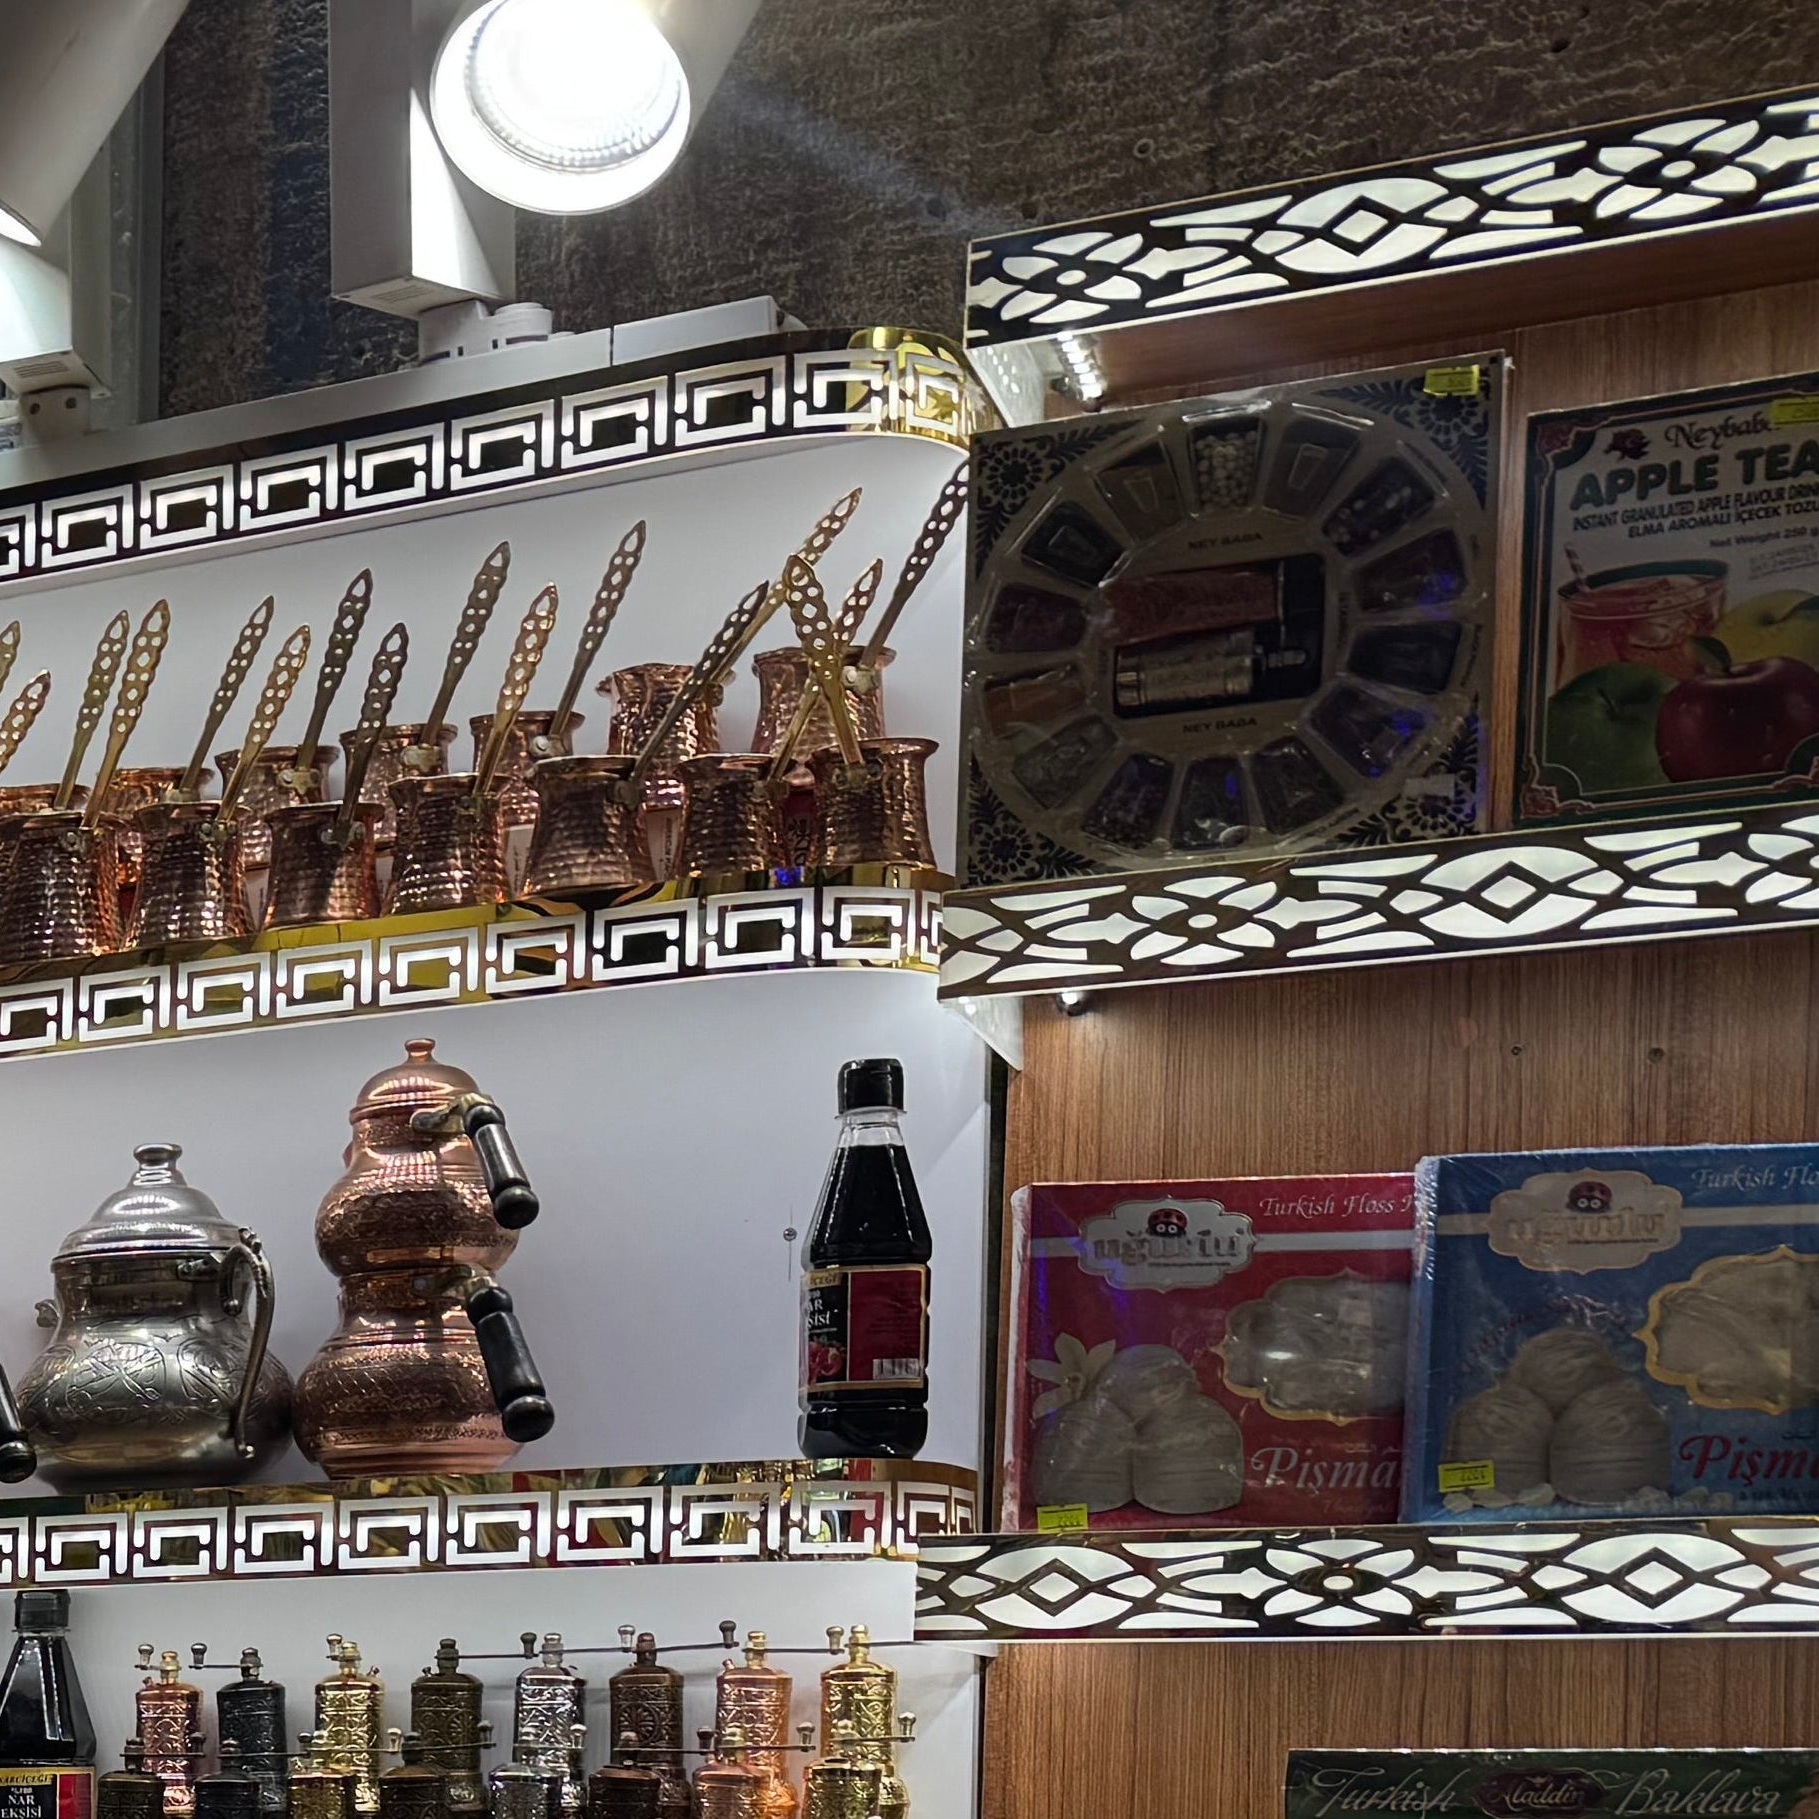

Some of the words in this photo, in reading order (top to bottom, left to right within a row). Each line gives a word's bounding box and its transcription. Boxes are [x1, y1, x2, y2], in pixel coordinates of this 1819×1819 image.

[1665, 411, 1776, 449] Neybab
[1569, 454, 1719, 511] APPLE
[1735, 440, 1819, 484] TEA
[1573, 511, 1619, 531] INSTANT
[1698, 496, 1730, 512] APPLE
[1629, 524, 1664, 537] ELMA
[1669, 512, 1730, 531] AROMALI
[1735, 502, 1781, 524] İÇECEK
[1691, 1164, 1776, 1192] Turkish
[1259, 1194, 1335, 1219] Turkish
[1343, 1195, 1395, 1217] Floss
[8, 1794, 35, 1806] NAR
[1503, 1778, 1585, 1808] Aladdin
[1603, 1767, 1781, 1816] Baklava
[1, 1807, 42, 1819] EKŞİSİ
